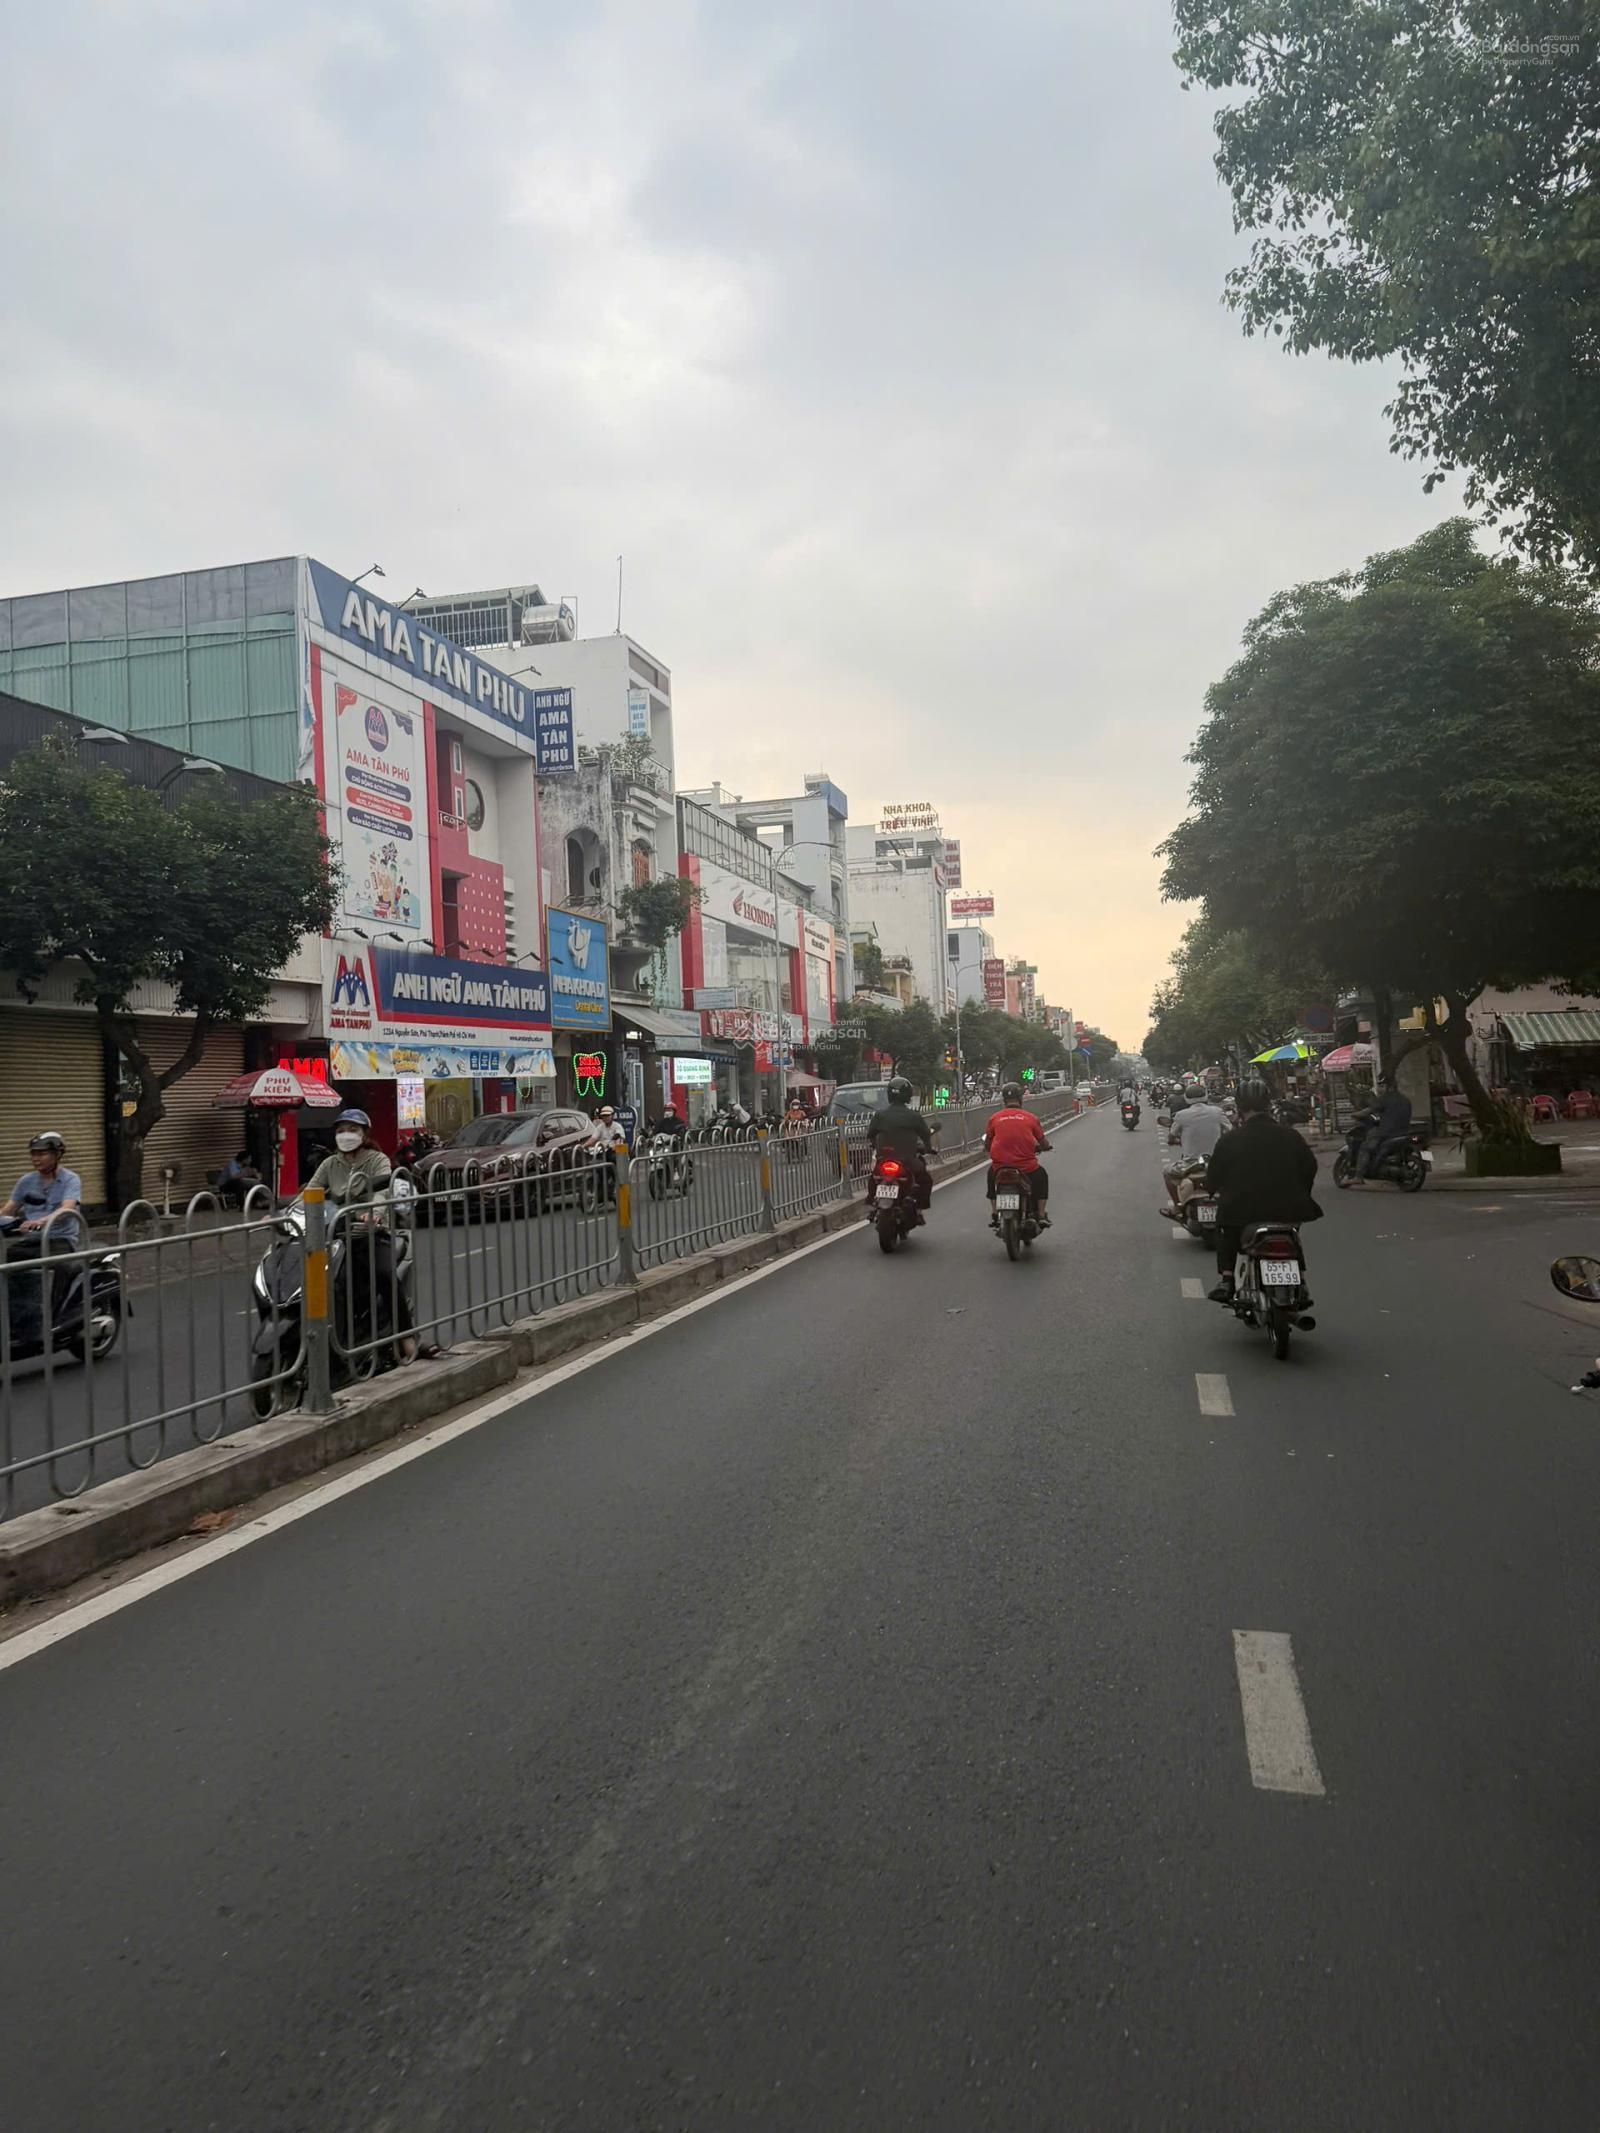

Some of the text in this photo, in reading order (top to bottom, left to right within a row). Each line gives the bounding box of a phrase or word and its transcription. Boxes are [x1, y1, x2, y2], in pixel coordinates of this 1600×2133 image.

[341, 590, 415, 664] AMA
[536, 695, 551, 708] ANH
[540, 711, 568, 726] AMA
[542, 729, 567, 745] TÂN
[542, 746, 568, 763] PHÚ
[346, 748, 369, 767] AMA
[371, 757, 389, 774] TÂN
[392, 766, 409, 781] PHÚ
[883, 802, 932, 815] NHA KHOA
[743, 902, 776, 929] HONDA
[393, 972, 428, 1000] ANH
[430, 972, 462, 1003] NGỮ
[463, 981, 494, 1007] AMA
[493, 980, 519, 1009] TÂN
[521, 984, 545, 1012] PHÚ
[330, 1018, 345, 1028] AMA
[278, 1057, 328, 1083] AMA
[266, 1077, 290, 1085] PHỤ
